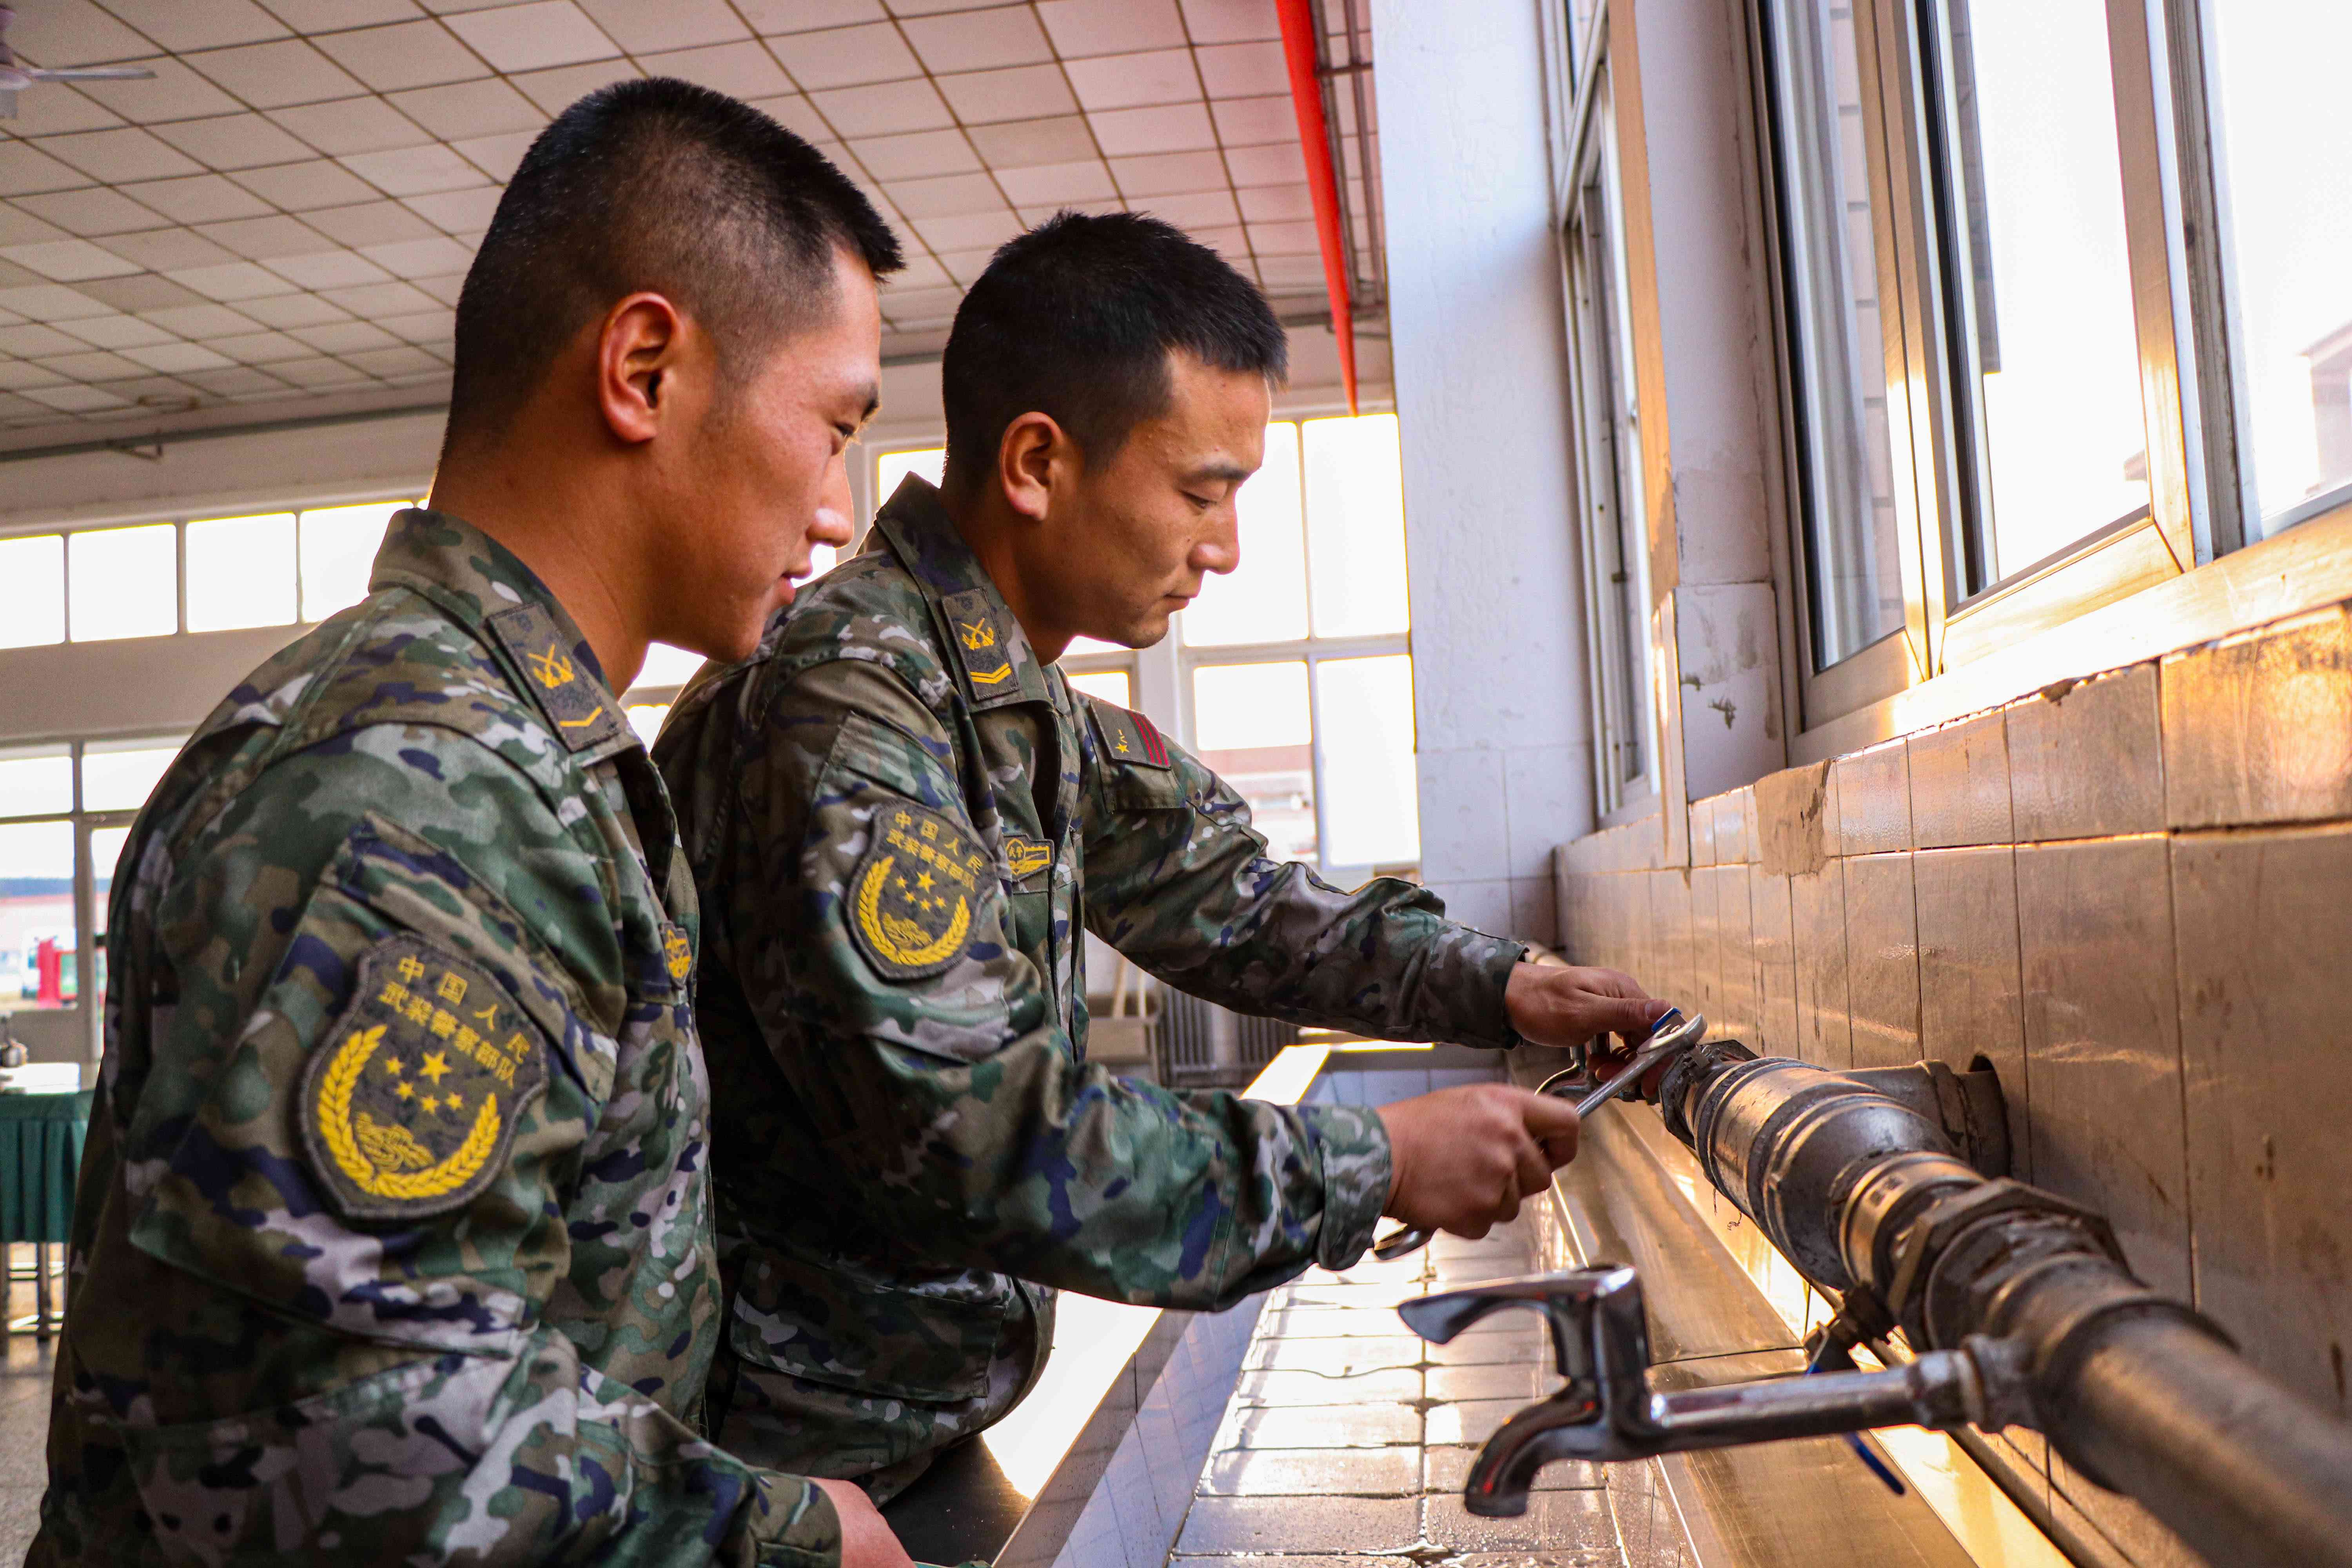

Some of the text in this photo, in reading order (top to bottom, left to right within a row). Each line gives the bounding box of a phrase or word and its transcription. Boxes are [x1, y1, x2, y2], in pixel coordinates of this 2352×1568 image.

[895, 810, 984, 875] 中国人民
[397, 954, 530, 1064] 中国人民
